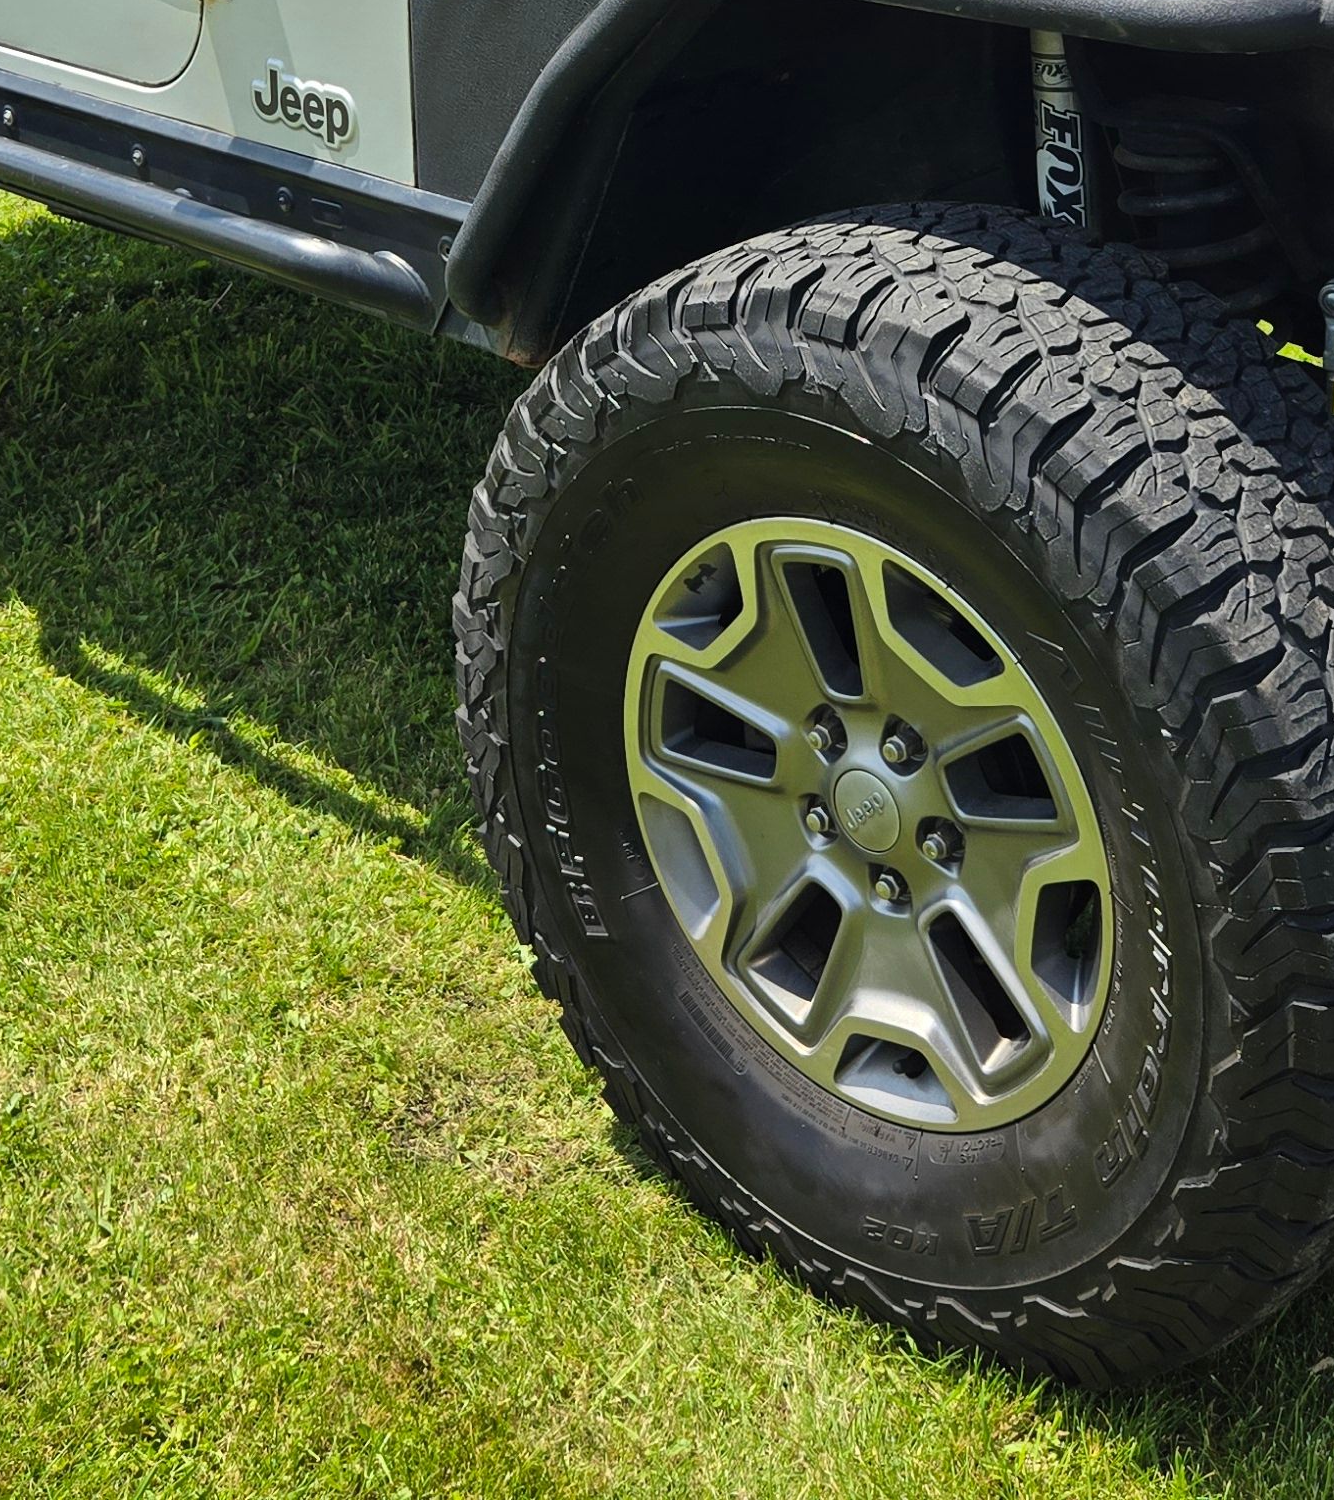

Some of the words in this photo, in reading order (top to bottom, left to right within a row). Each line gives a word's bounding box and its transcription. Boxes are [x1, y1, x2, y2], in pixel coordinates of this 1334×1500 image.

[1034, 61, 1066, 81] FOX
[252, 65, 352, 147] Jeep
[1039, 100, 1085, 229] FOX
[845, 791, 884, 830] Jeep
